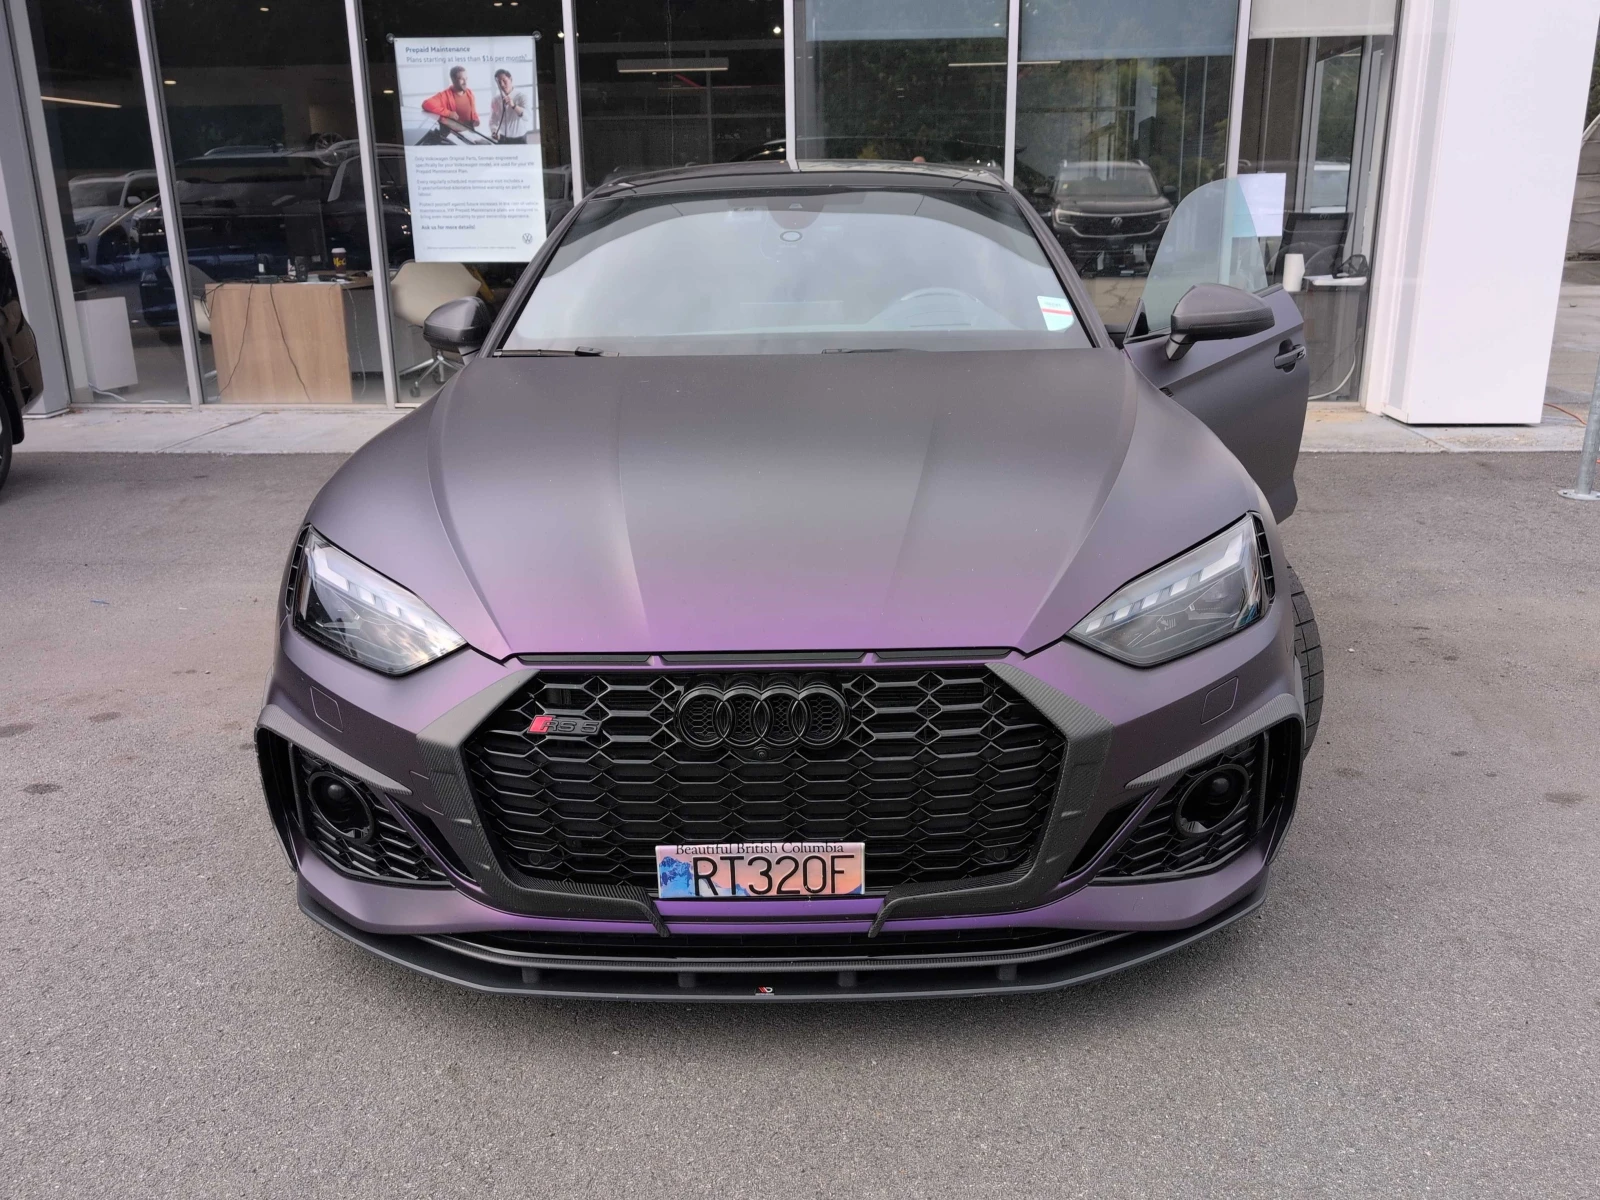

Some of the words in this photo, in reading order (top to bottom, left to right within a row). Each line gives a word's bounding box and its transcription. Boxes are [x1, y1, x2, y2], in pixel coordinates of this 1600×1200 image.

[676, 843, 732, 855] Beautiful
[736, 843, 778, 854] British
[781, 842, 844, 854] Columbia
[692, 855, 854, 896] RT320F
